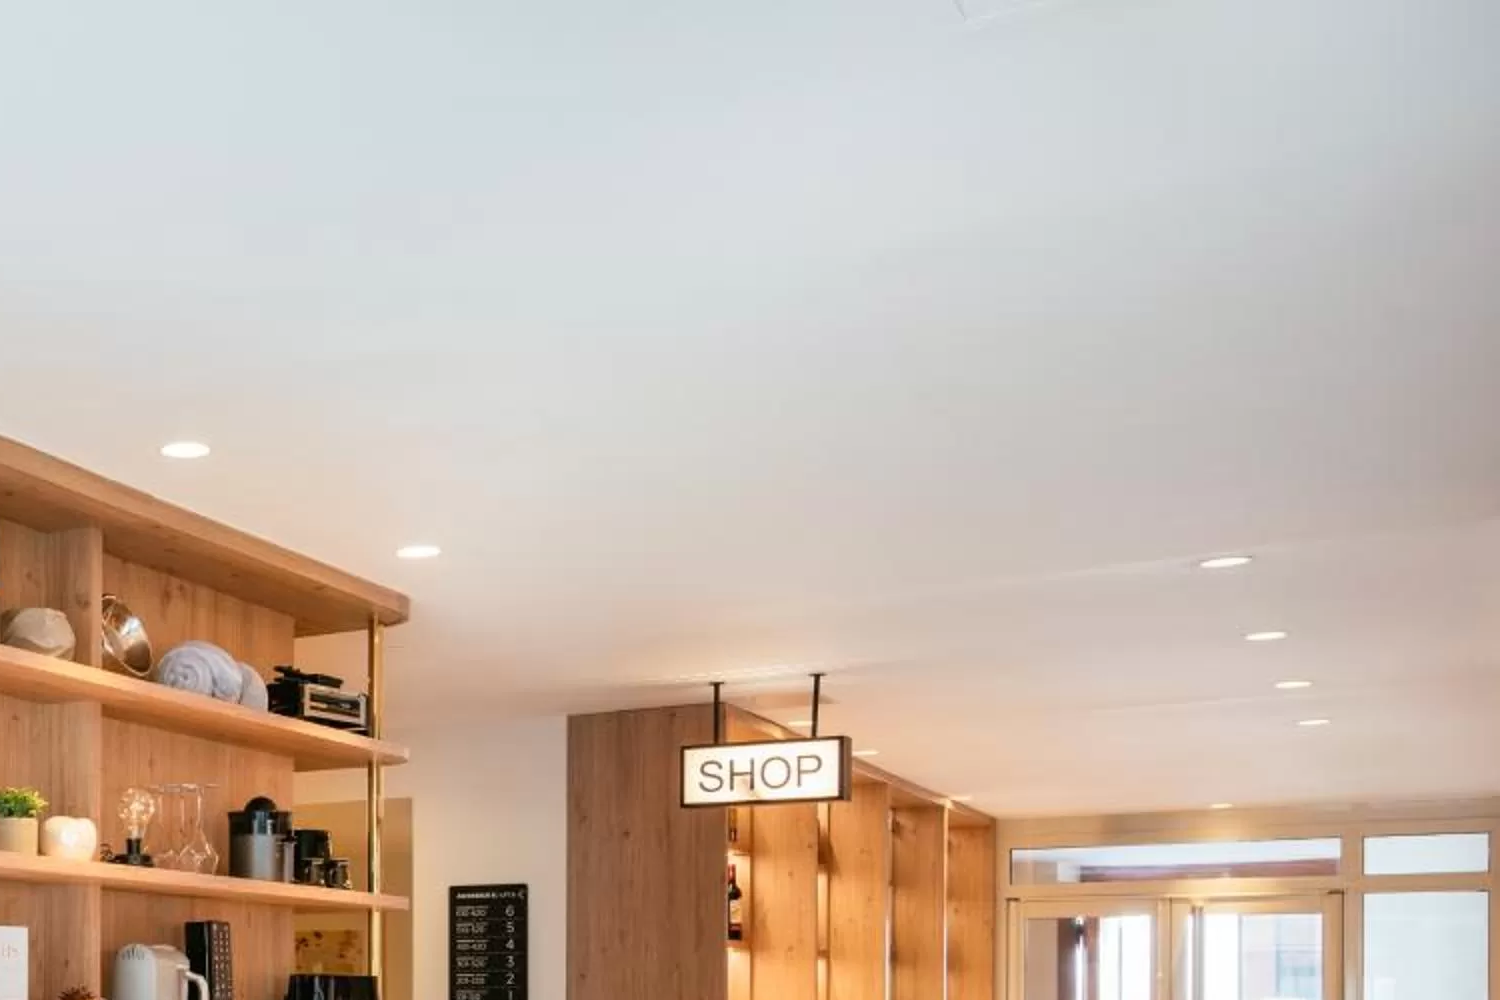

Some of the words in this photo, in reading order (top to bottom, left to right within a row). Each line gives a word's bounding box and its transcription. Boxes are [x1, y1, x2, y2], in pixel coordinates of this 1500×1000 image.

[699, 754, 822, 793] SHOP
[505, 904, 515, 917] 6
[505, 921, 515, 933] 5
[505, 938, 515, 950] 4
[505, 956, 515, 968] 3
[505, 973, 516, 985] 2
